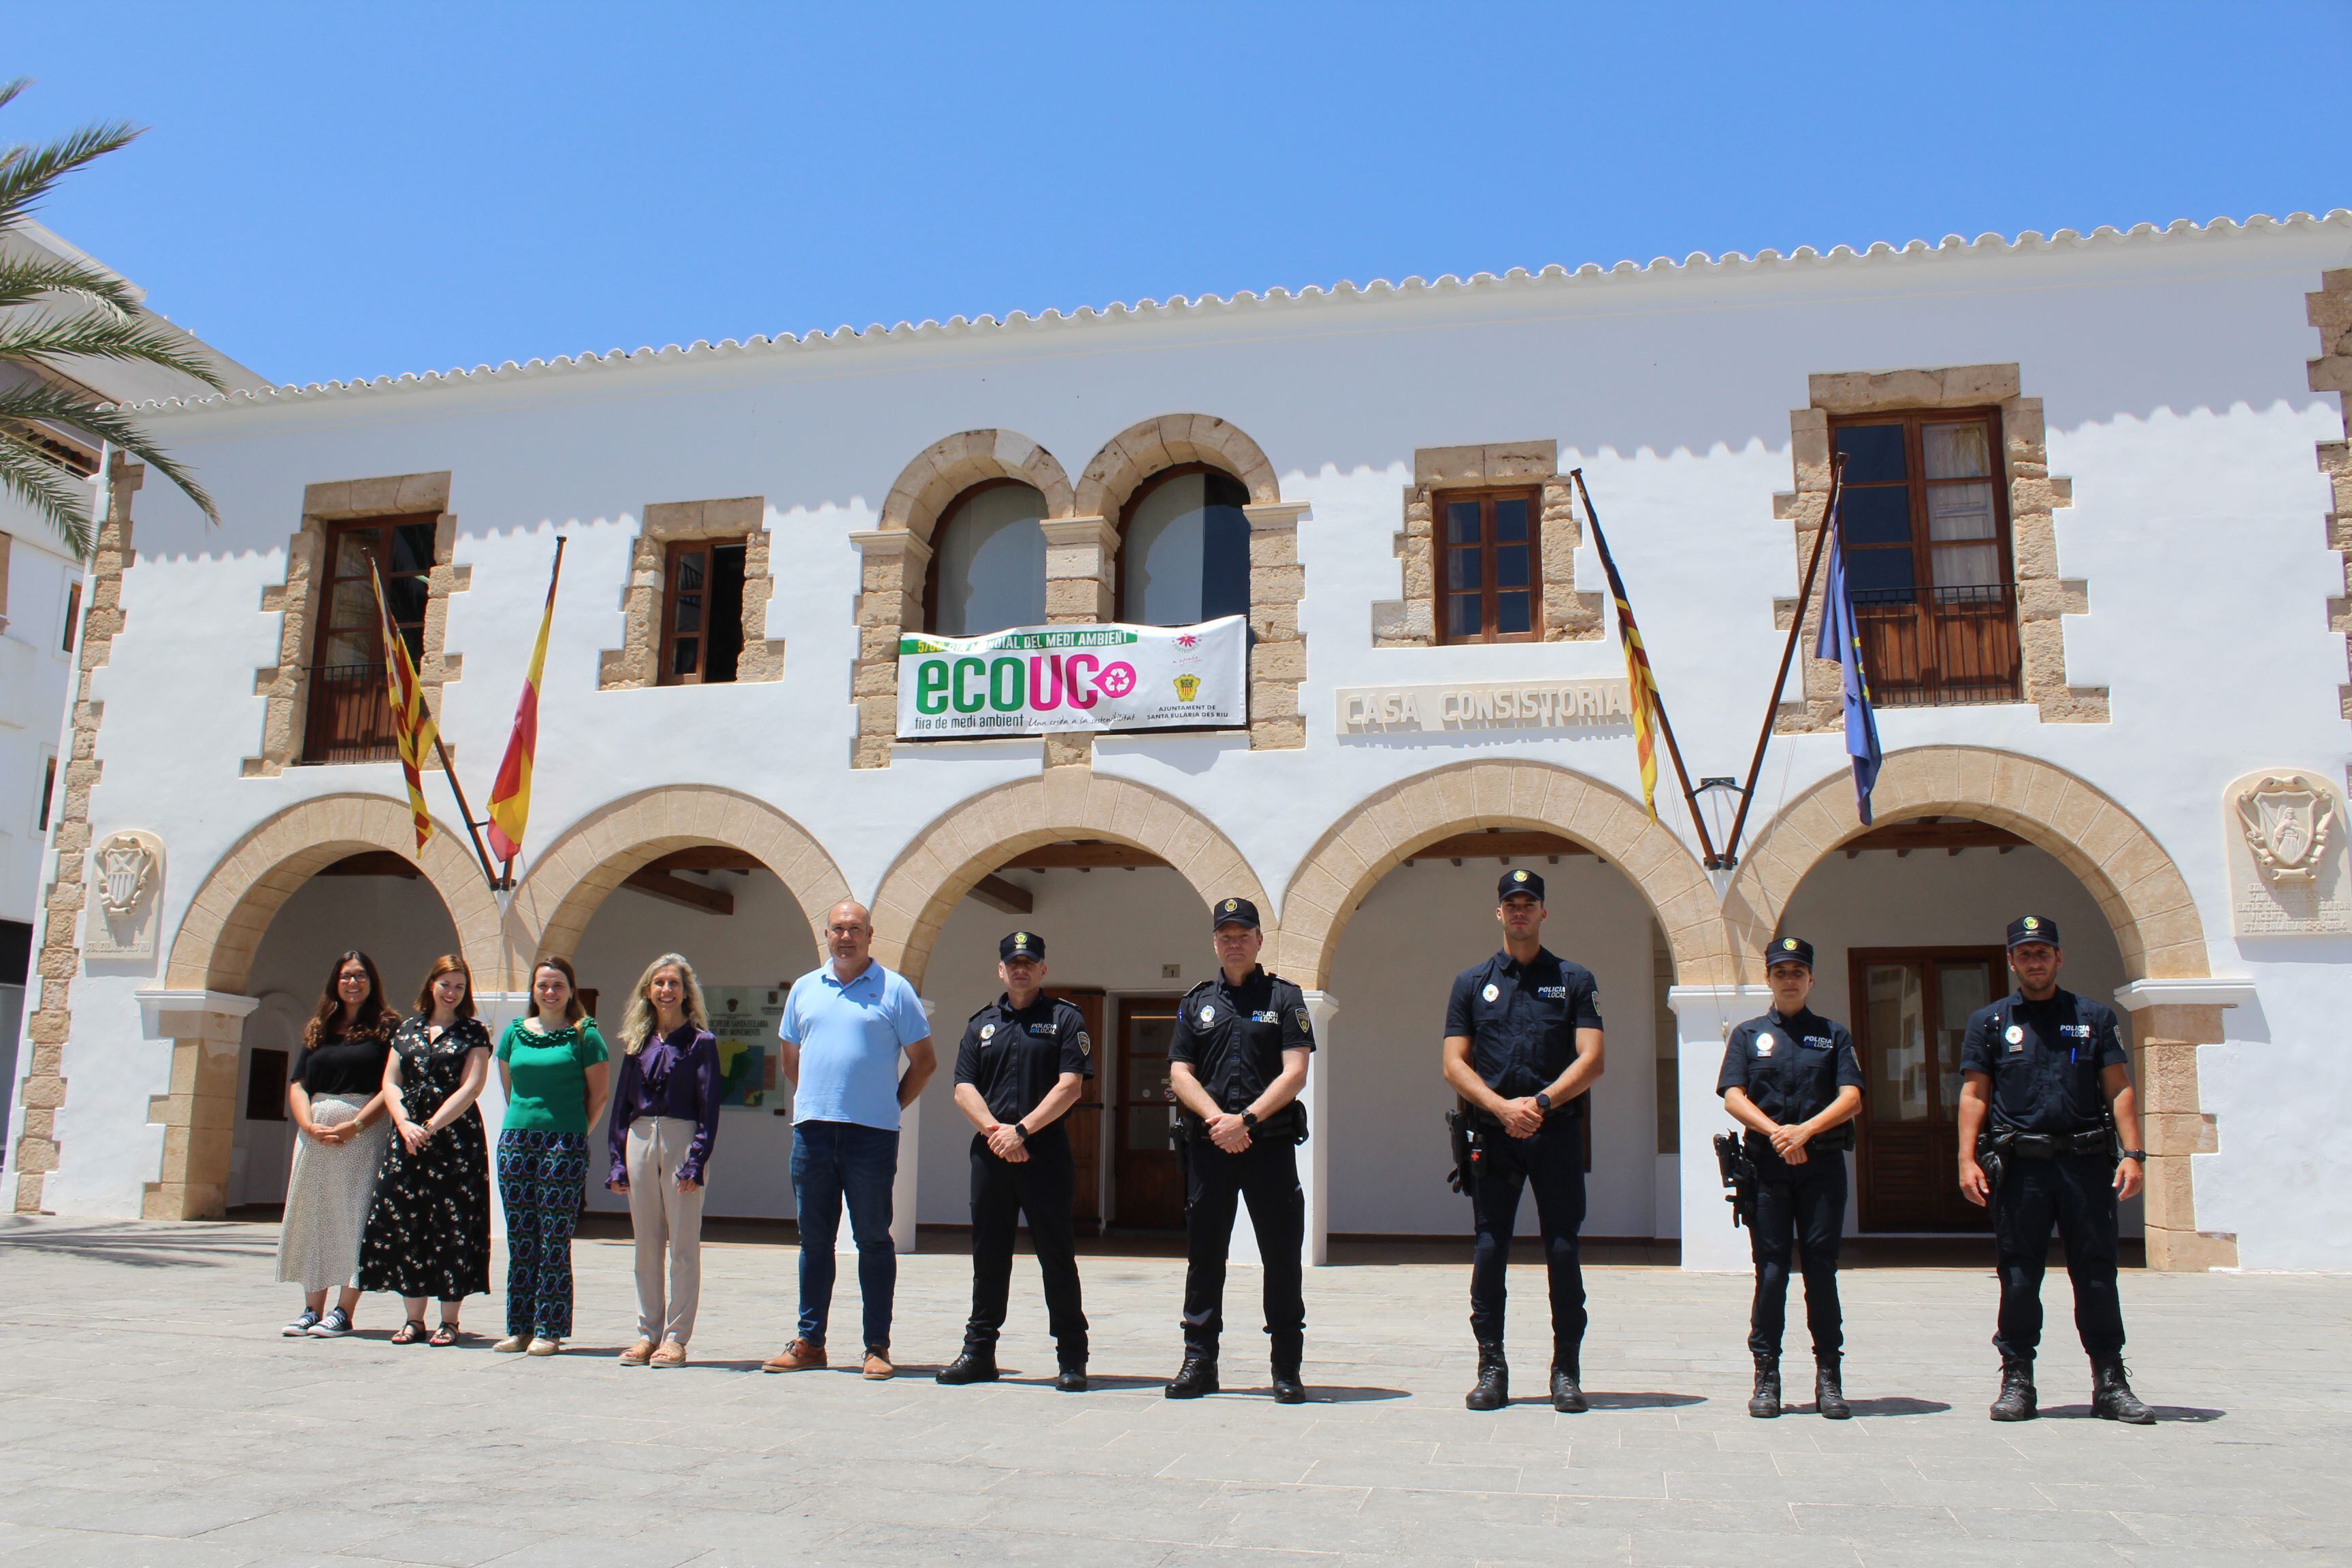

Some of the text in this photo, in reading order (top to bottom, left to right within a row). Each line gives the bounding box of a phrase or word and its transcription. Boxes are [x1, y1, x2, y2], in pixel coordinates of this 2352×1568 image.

[1024, 636, 1043, 649] DEL
[1045, 633, 1075, 647] MEDI
[1077, 630, 1128, 646] AMBIENT
[1345, 692, 1421, 724] CASA
[915, 713, 1024, 730] fira de medi ambient
[1028, 717, 1047, 727] Una
[1049, 715, 1068, 725] crida
